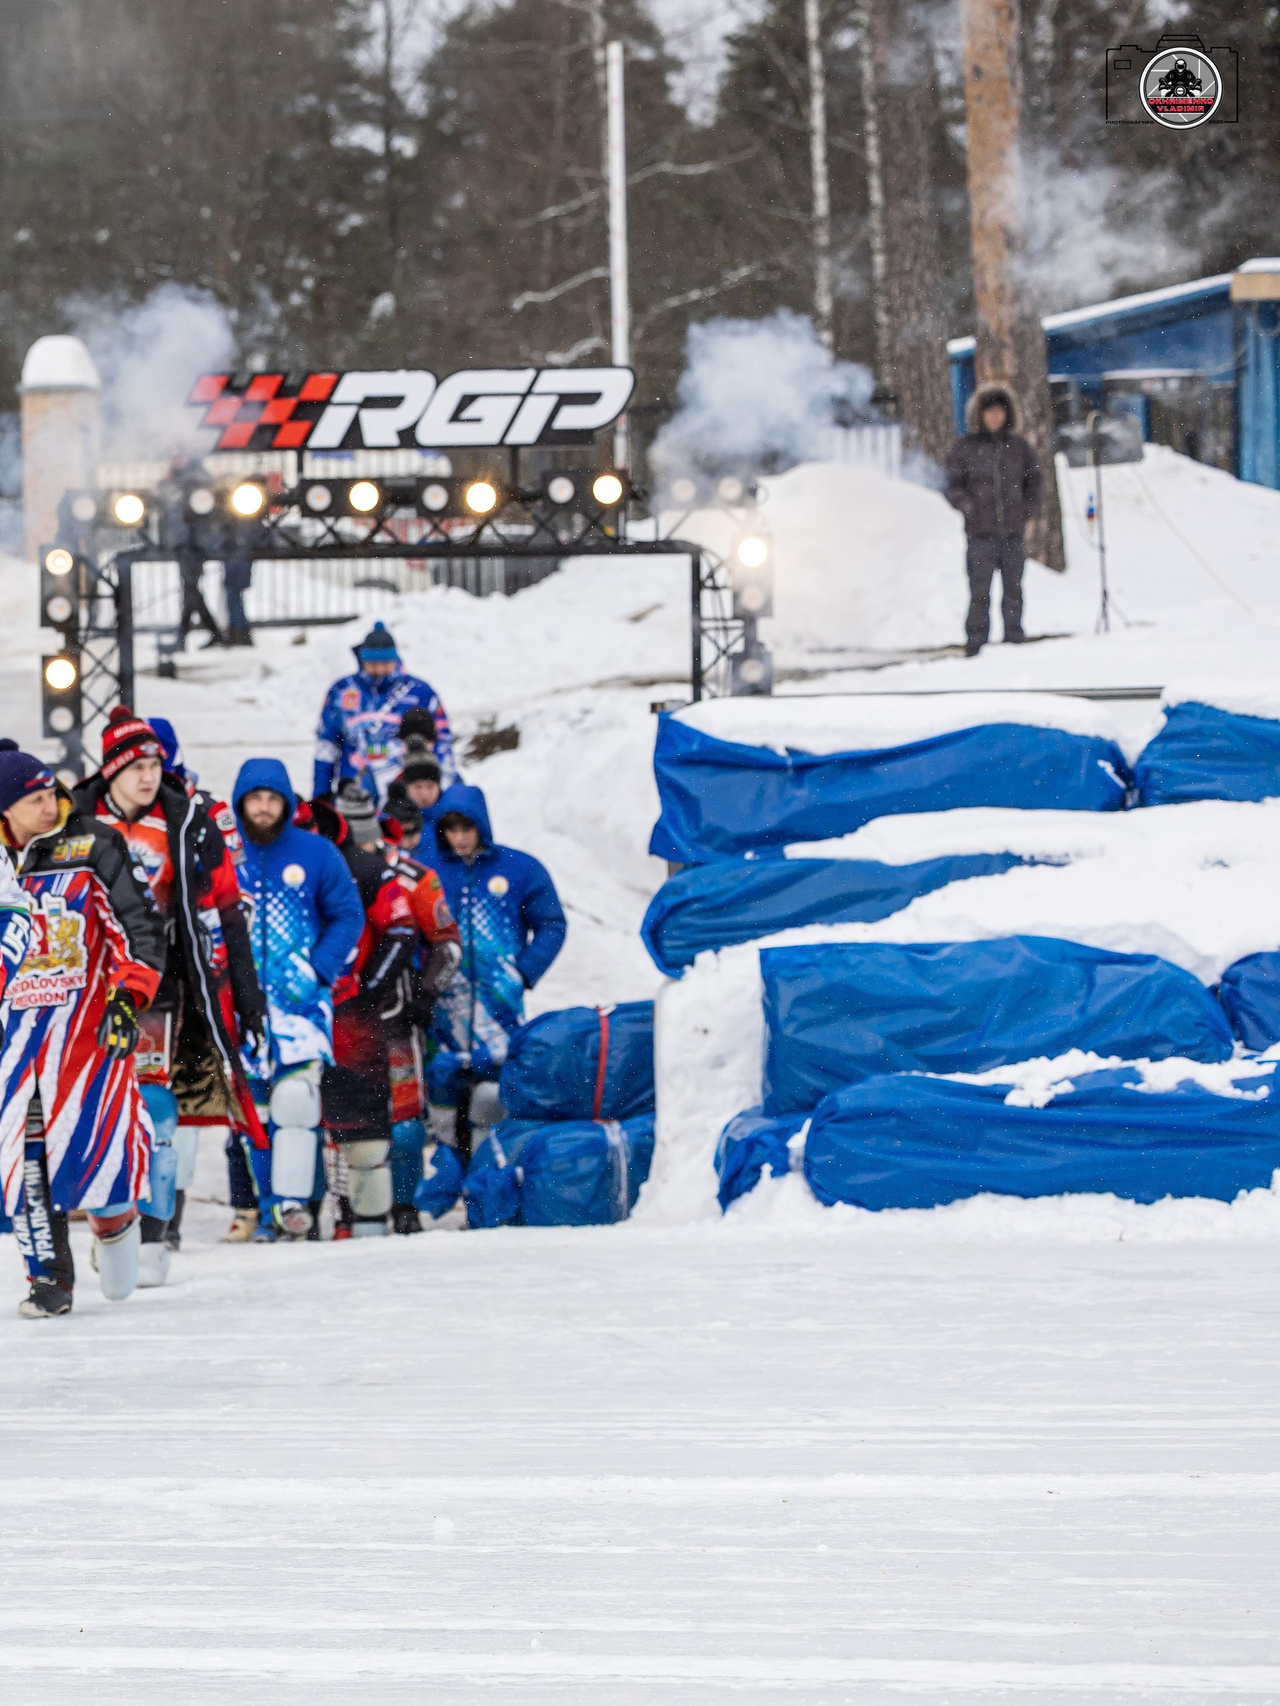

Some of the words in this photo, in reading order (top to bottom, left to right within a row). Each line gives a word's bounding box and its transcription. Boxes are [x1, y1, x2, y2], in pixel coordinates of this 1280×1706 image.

[307, 367, 634, 448] RGP
[0, 912, 31, 965] UFA
[14, 1212, 35, 1257] КАМ
